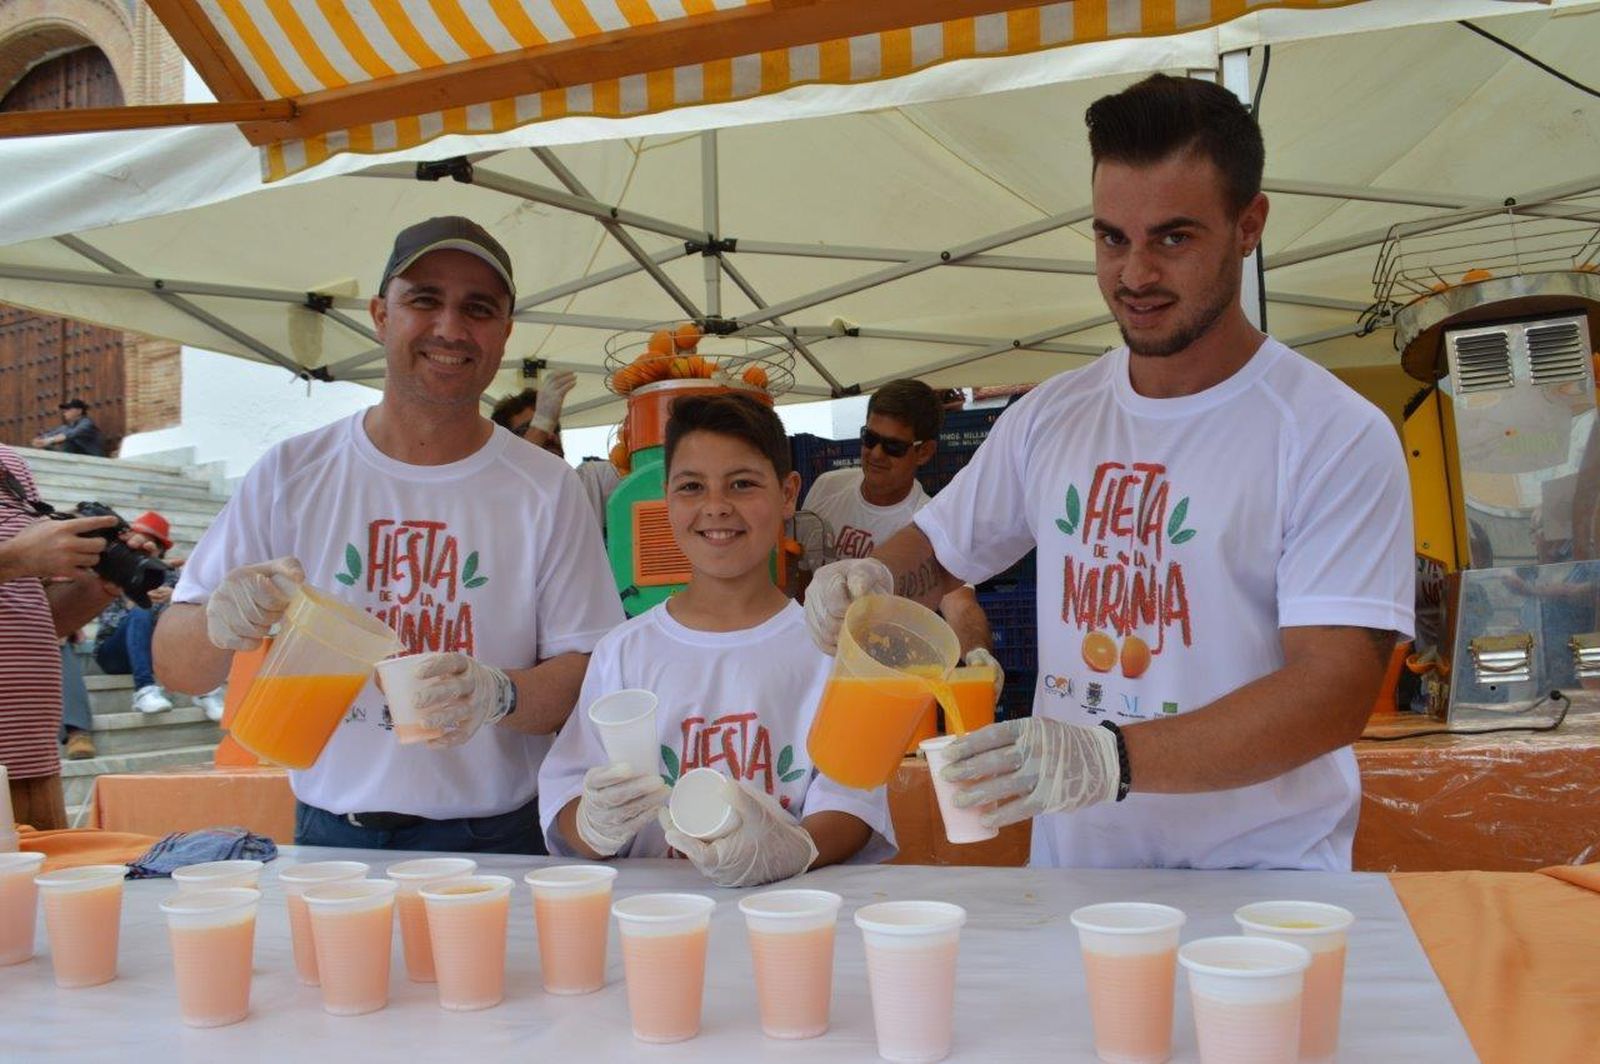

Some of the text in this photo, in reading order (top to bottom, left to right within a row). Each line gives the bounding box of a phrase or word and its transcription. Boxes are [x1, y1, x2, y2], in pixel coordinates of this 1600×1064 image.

[1082, 462, 1170, 562] FIETA
[367, 519, 459, 604] FIESTA
[1093, 543, 1148, 569] DE LA
[379, 590, 434, 607] DE LA
[365, 601, 474, 658] ANJA
